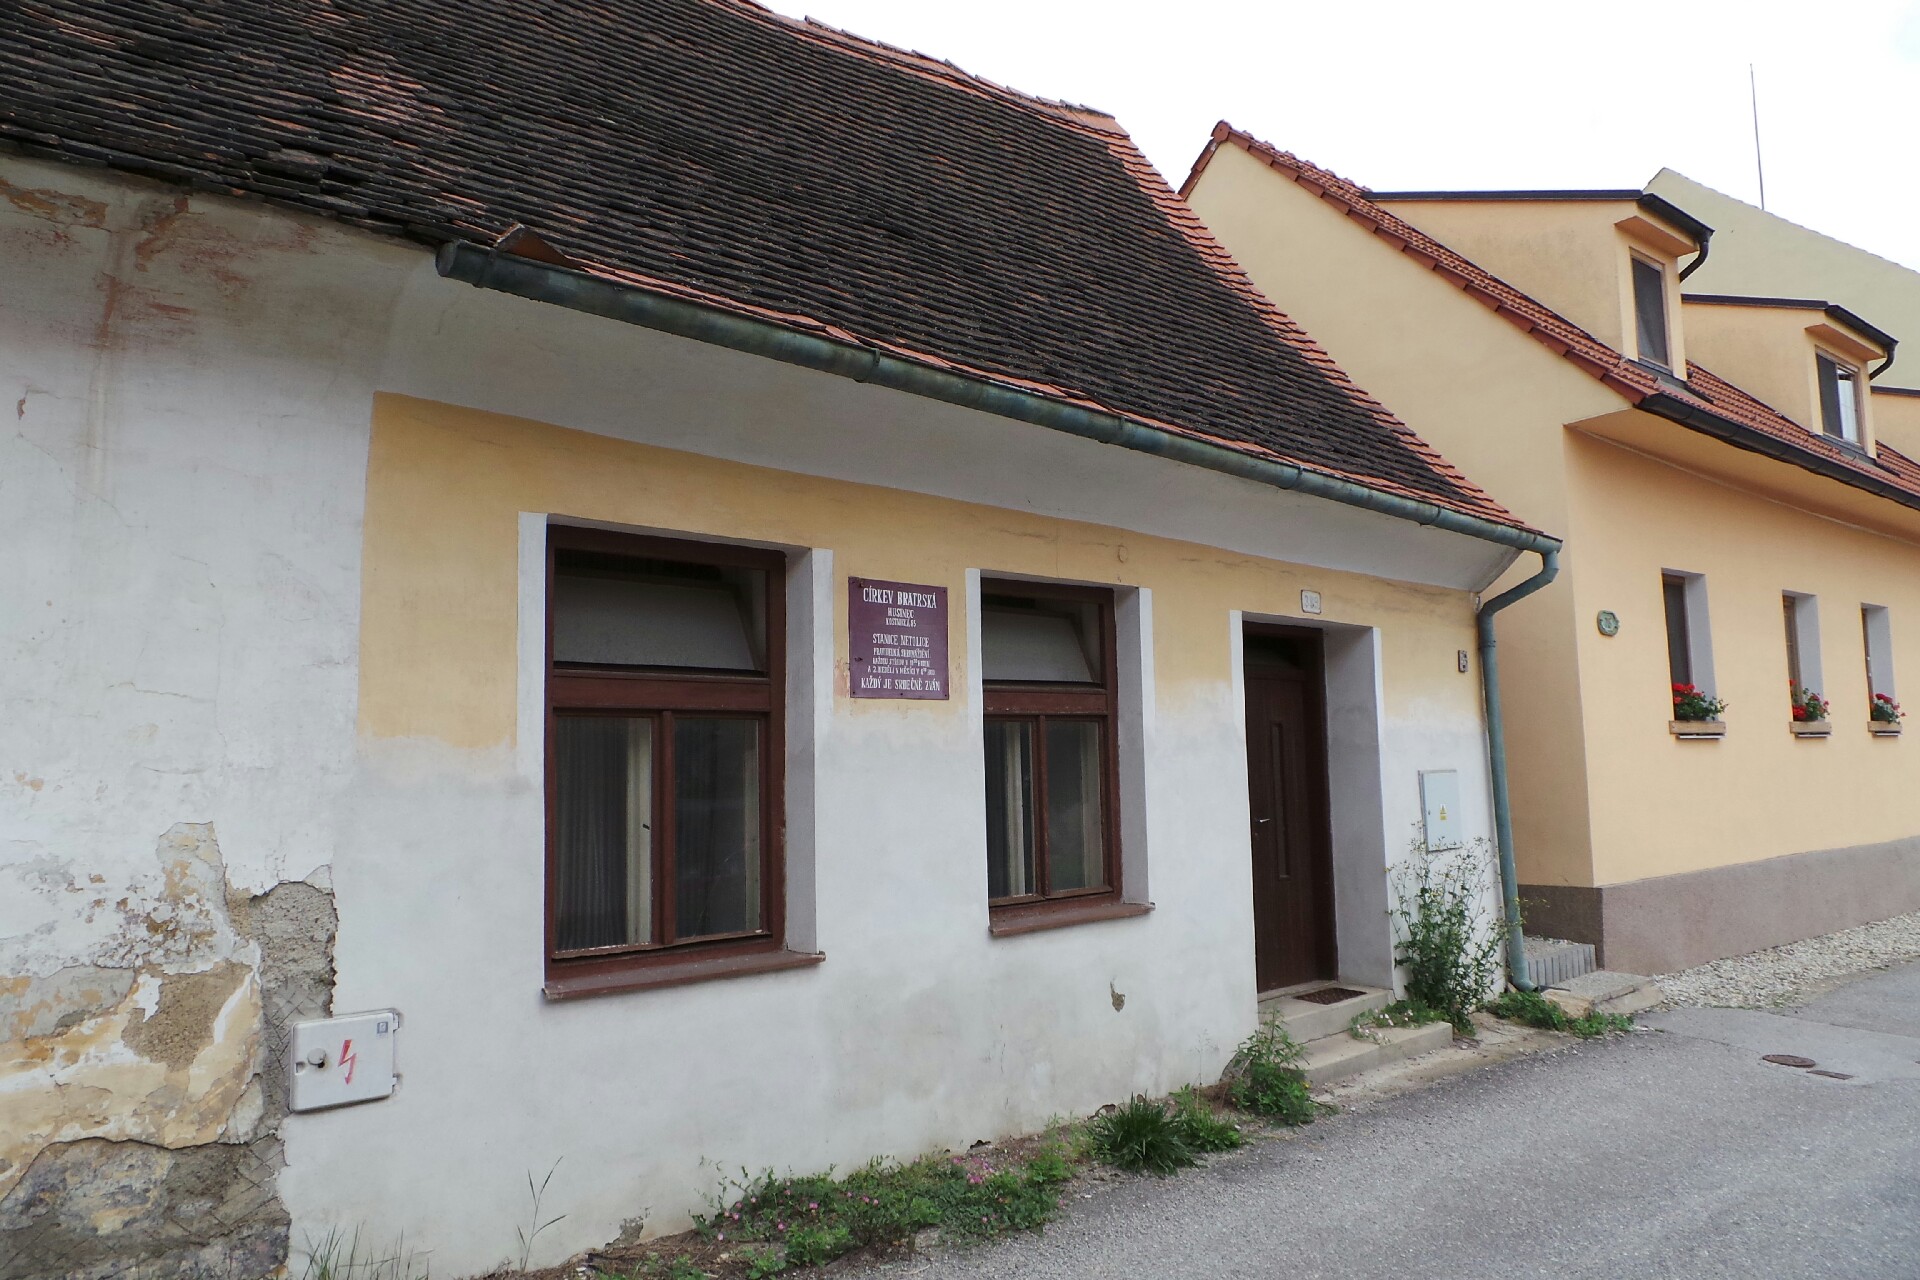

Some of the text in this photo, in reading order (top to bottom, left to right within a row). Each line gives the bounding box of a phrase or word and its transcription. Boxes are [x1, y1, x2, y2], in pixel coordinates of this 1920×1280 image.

[863, 585, 937, 609] CÍRKEV BRATRSKÁ
[887, 607, 915, 619] HUSINEC
[872, 633, 930, 648] STANICE NETOLICE
[861, 675, 940, 691] KAŽDÝ JE SRDEČNĚ ZVÁN
